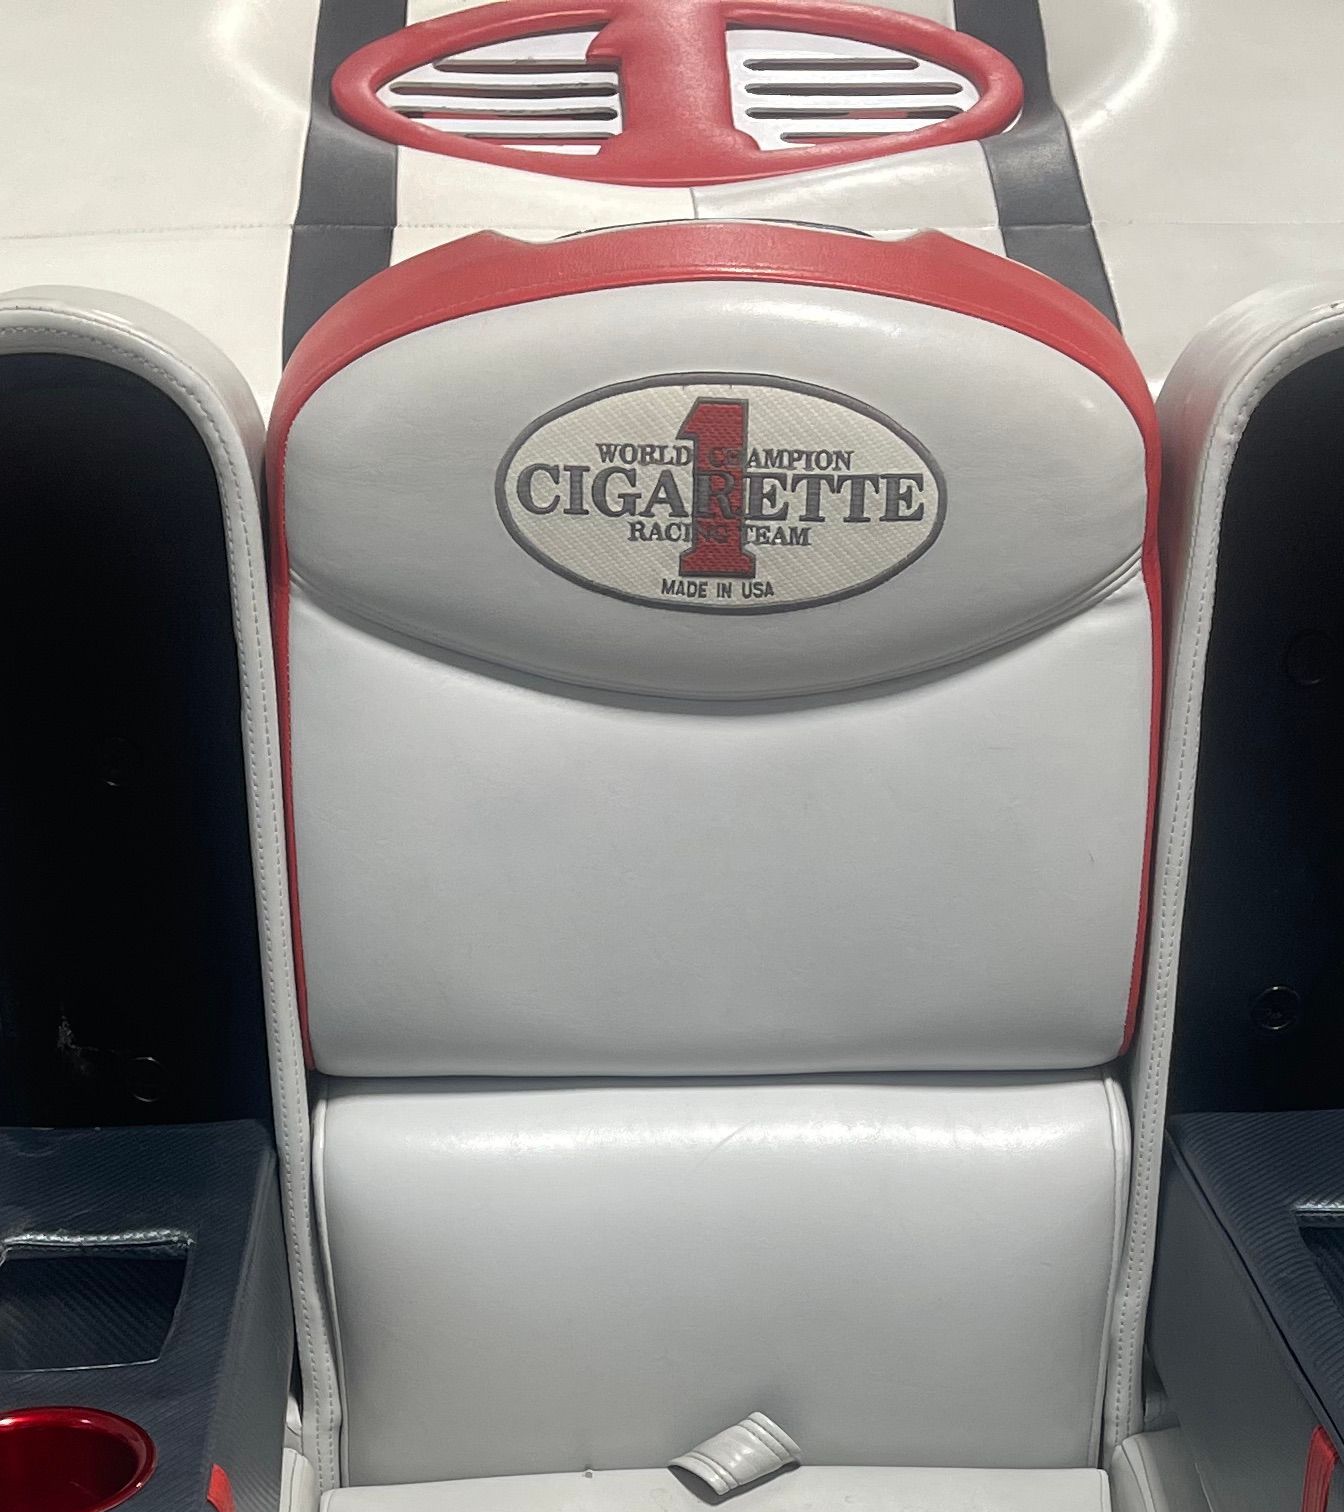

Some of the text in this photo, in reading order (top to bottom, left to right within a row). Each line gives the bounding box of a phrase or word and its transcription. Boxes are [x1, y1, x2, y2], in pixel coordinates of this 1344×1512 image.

[596, 443, 693, 466] WORLD
[517, 463, 924, 522] CIGARETTE
[676, 397, 757, 578] 1
[628, 521, 812, 546] RACING TEAM
[661, 578, 775, 599] MADE IN USA
